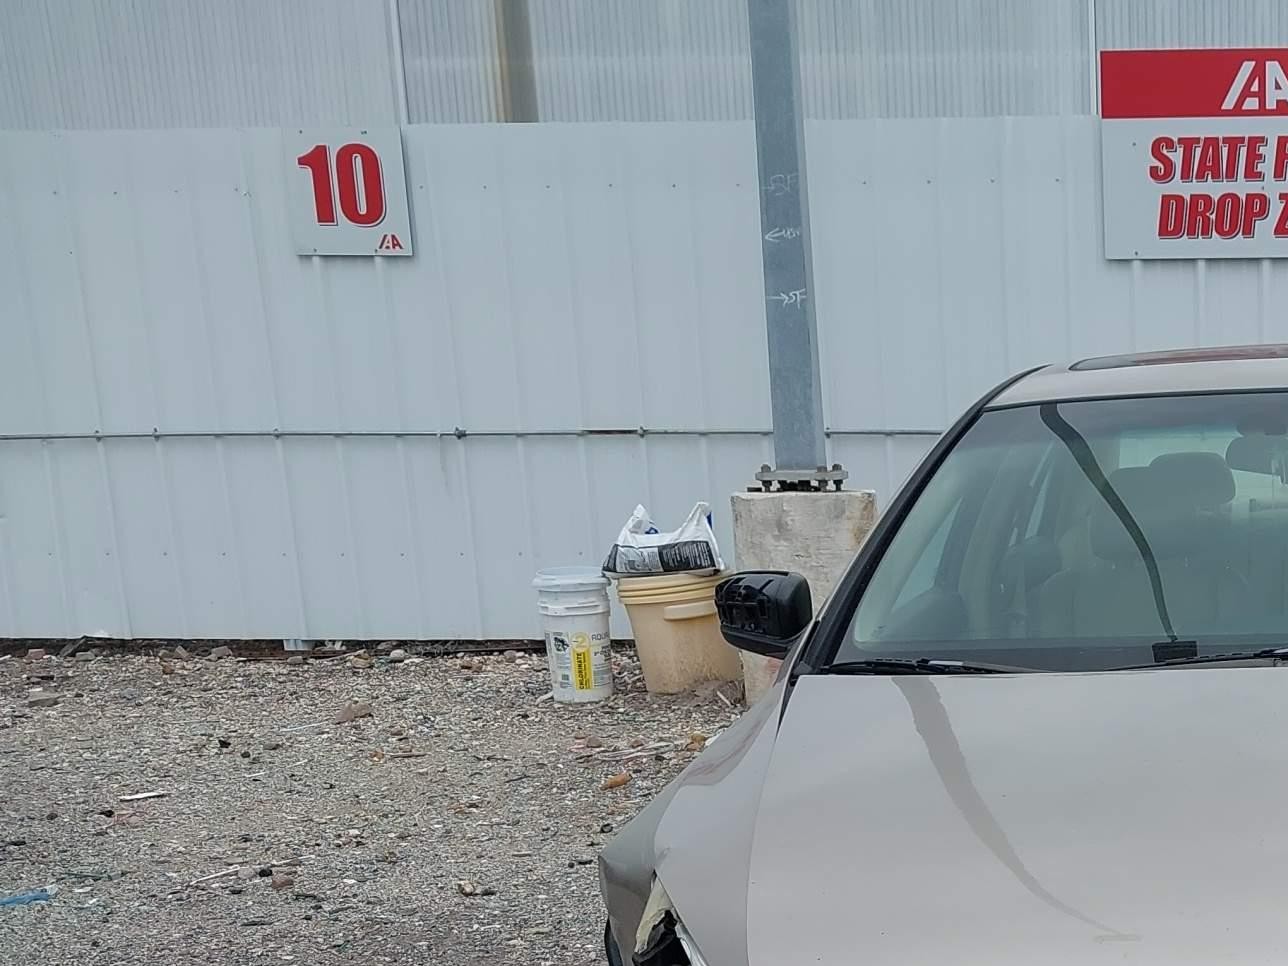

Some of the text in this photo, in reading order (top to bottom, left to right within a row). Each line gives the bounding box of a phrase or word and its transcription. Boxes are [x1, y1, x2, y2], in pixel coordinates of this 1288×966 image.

[1149, 136, 1266, 183] STATE
[297, 142, 386, 227] 10
[1157, 193, 1269, 240] DROP
